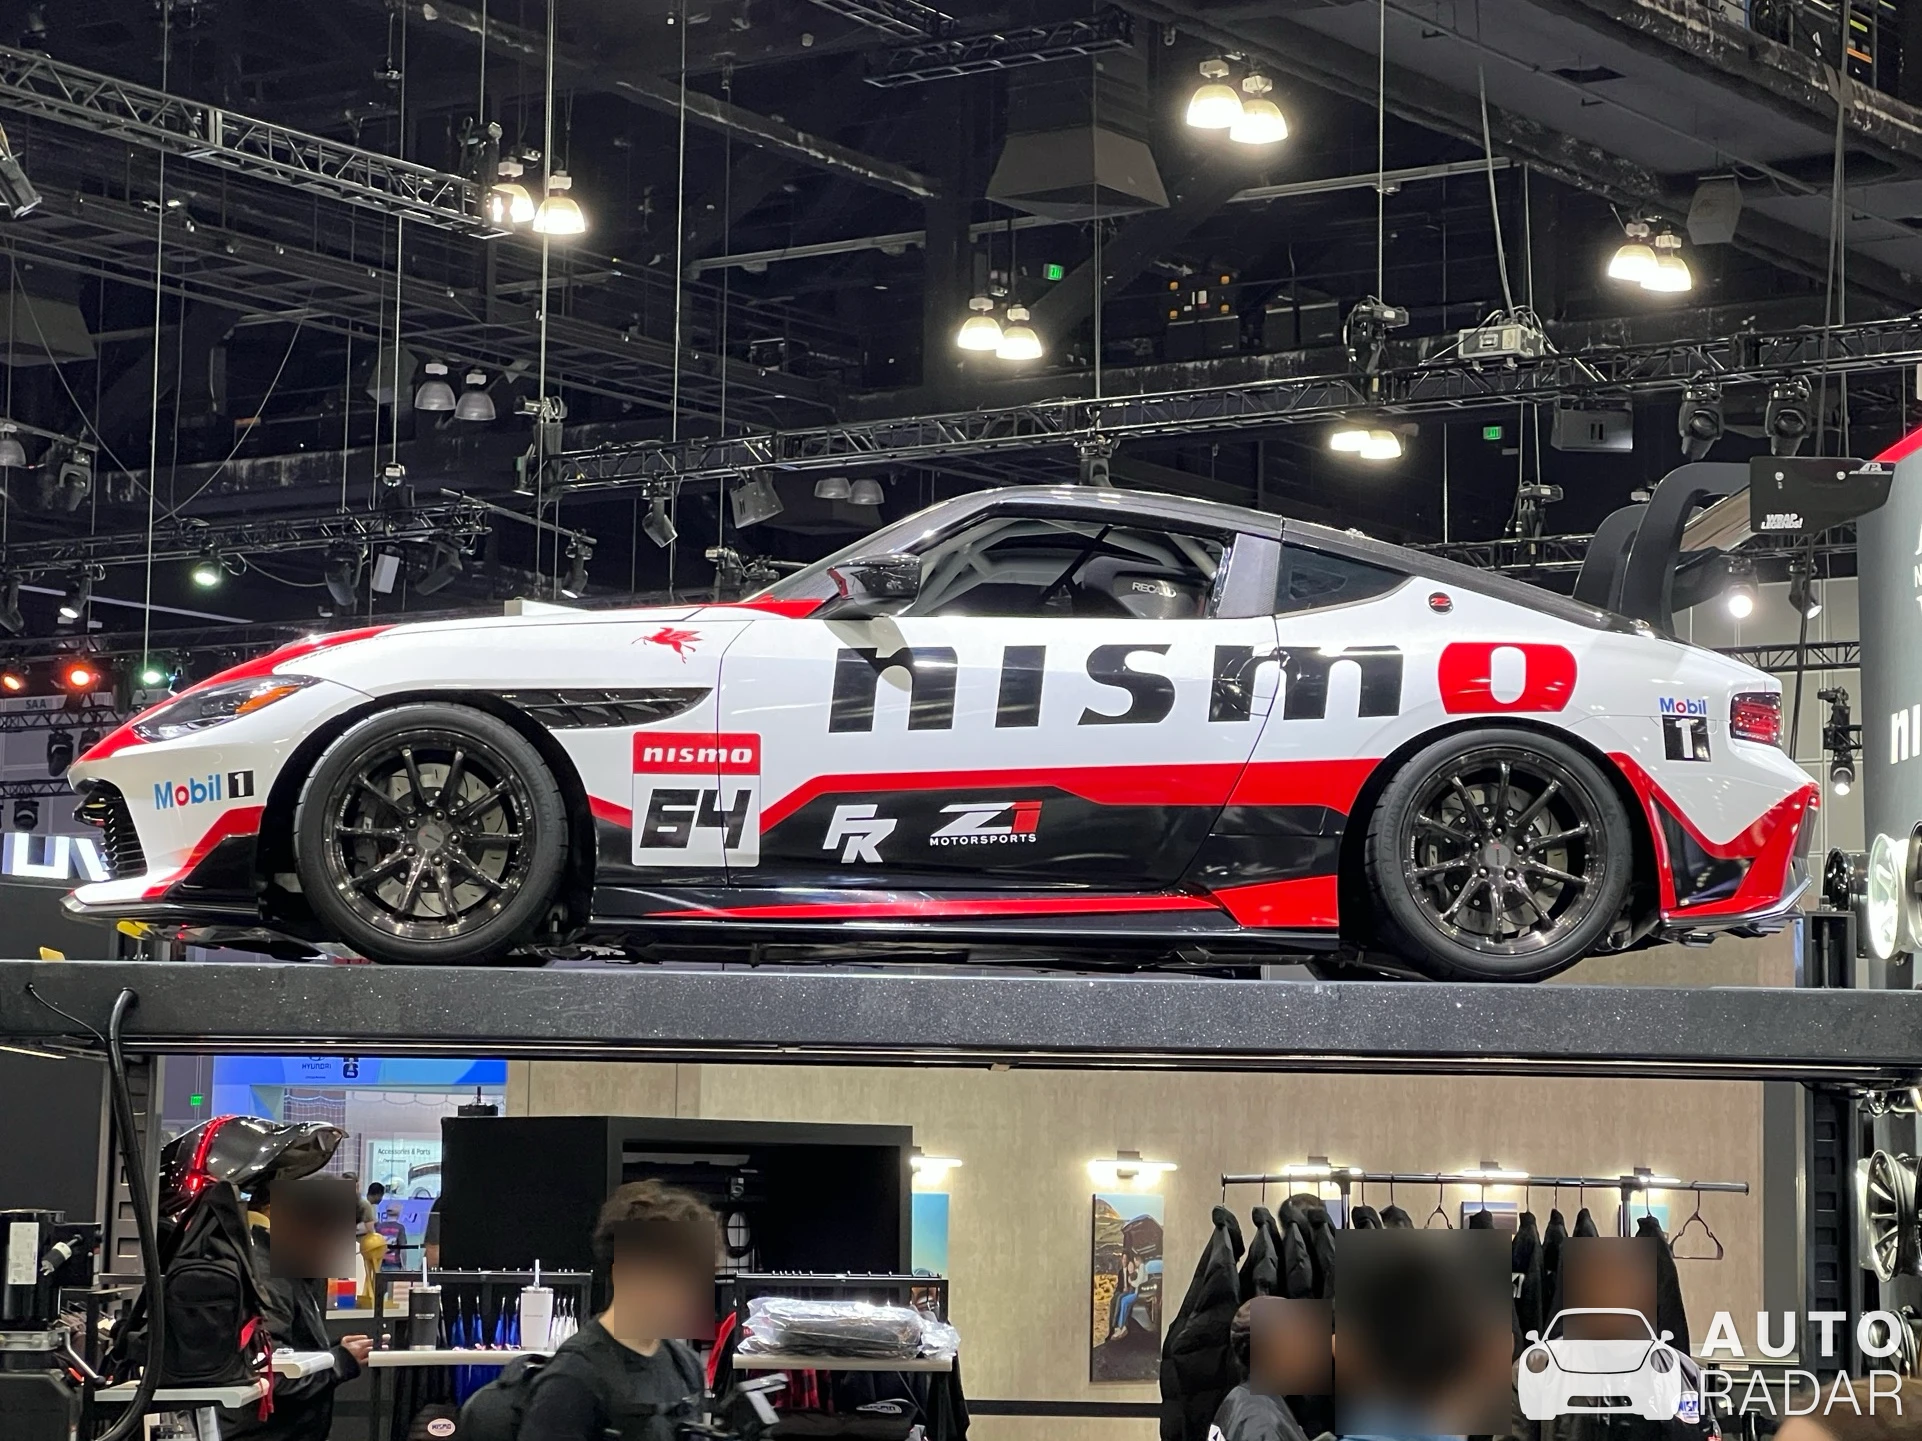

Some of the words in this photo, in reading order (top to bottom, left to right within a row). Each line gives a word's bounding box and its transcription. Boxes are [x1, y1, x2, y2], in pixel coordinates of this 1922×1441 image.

[1659, 697, 1707, 715] Mobil
[643, 747, 752, 763] nismo
[154, 774, 222, 810] Mobil
[640, 788, 752, 849] 64
[929, 833, 1038, 846] MOTORSPORTS
[377, 1148, 410, 1156] Accessories
[416, 1148, 432, 1156] Parts
